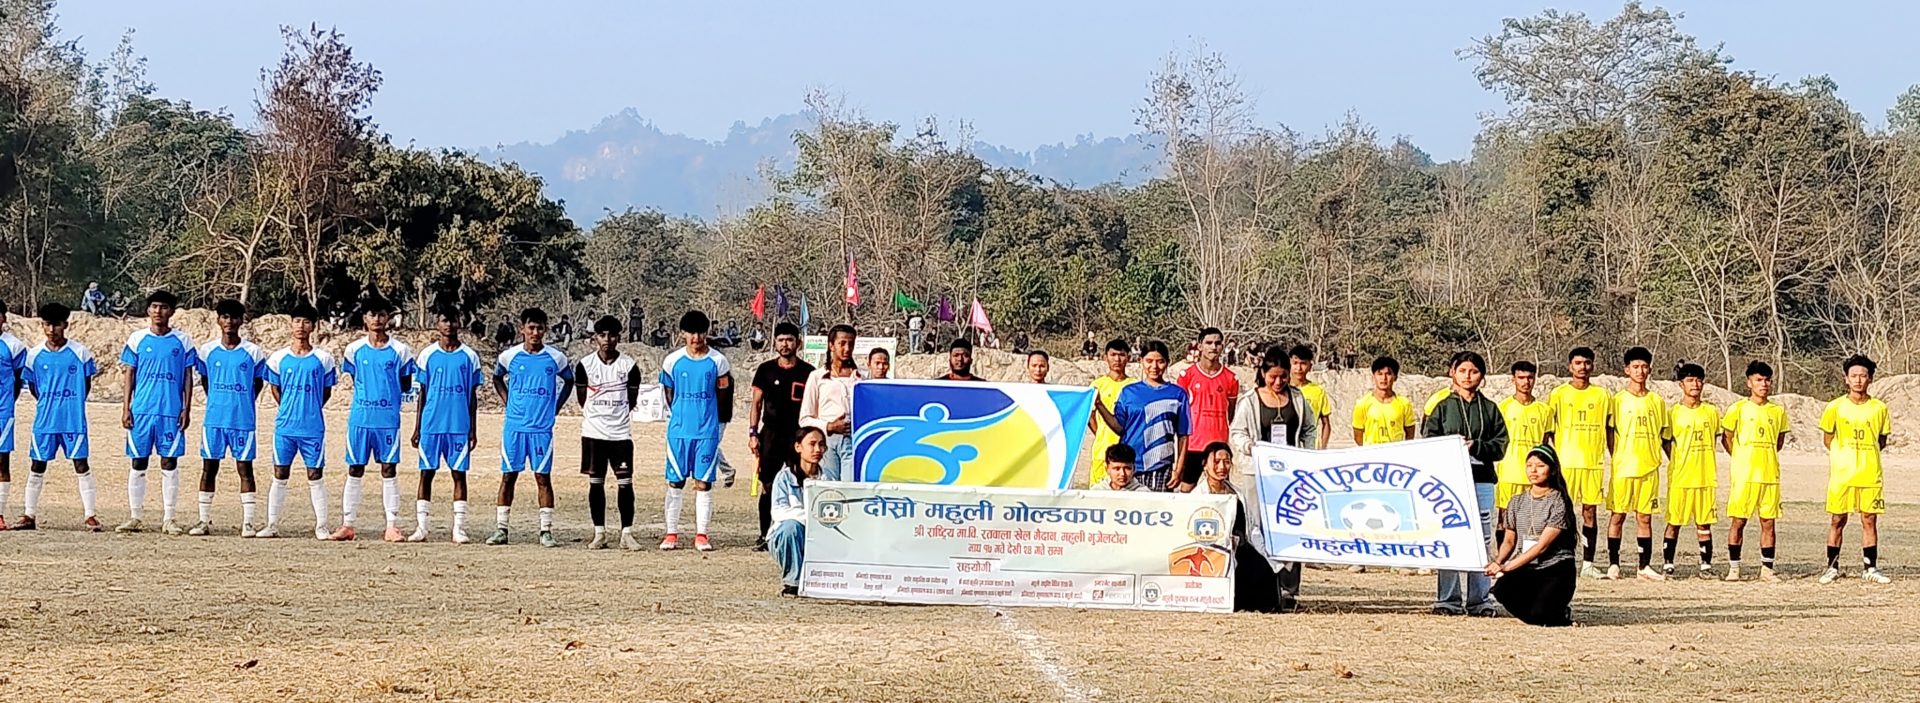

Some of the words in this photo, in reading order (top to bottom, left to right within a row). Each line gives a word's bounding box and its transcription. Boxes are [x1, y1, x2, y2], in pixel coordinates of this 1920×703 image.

[1578, 410, 1587, 421] 11
[1694, 430, 1703, 441] 12
[1759, 426, 1765, 438] 9
[1276, 469, 1327, 526] महुली
[1320, 462, 1421, 492] फुटबल
[925, 500, 995, 524] महुली
[1003, 501, 1106, 524] गोल्डकप
[1114, 510, 1174, 527] २०८२
[1014, 528, 1031, 541] खेल
[1061, 530, 1085, 545] महुली
[1300, 538, 1370, 556] महुली
[1374, 540, 1451, 558] सप्तरी
[956, 561, 991, 573] सहयोगी
